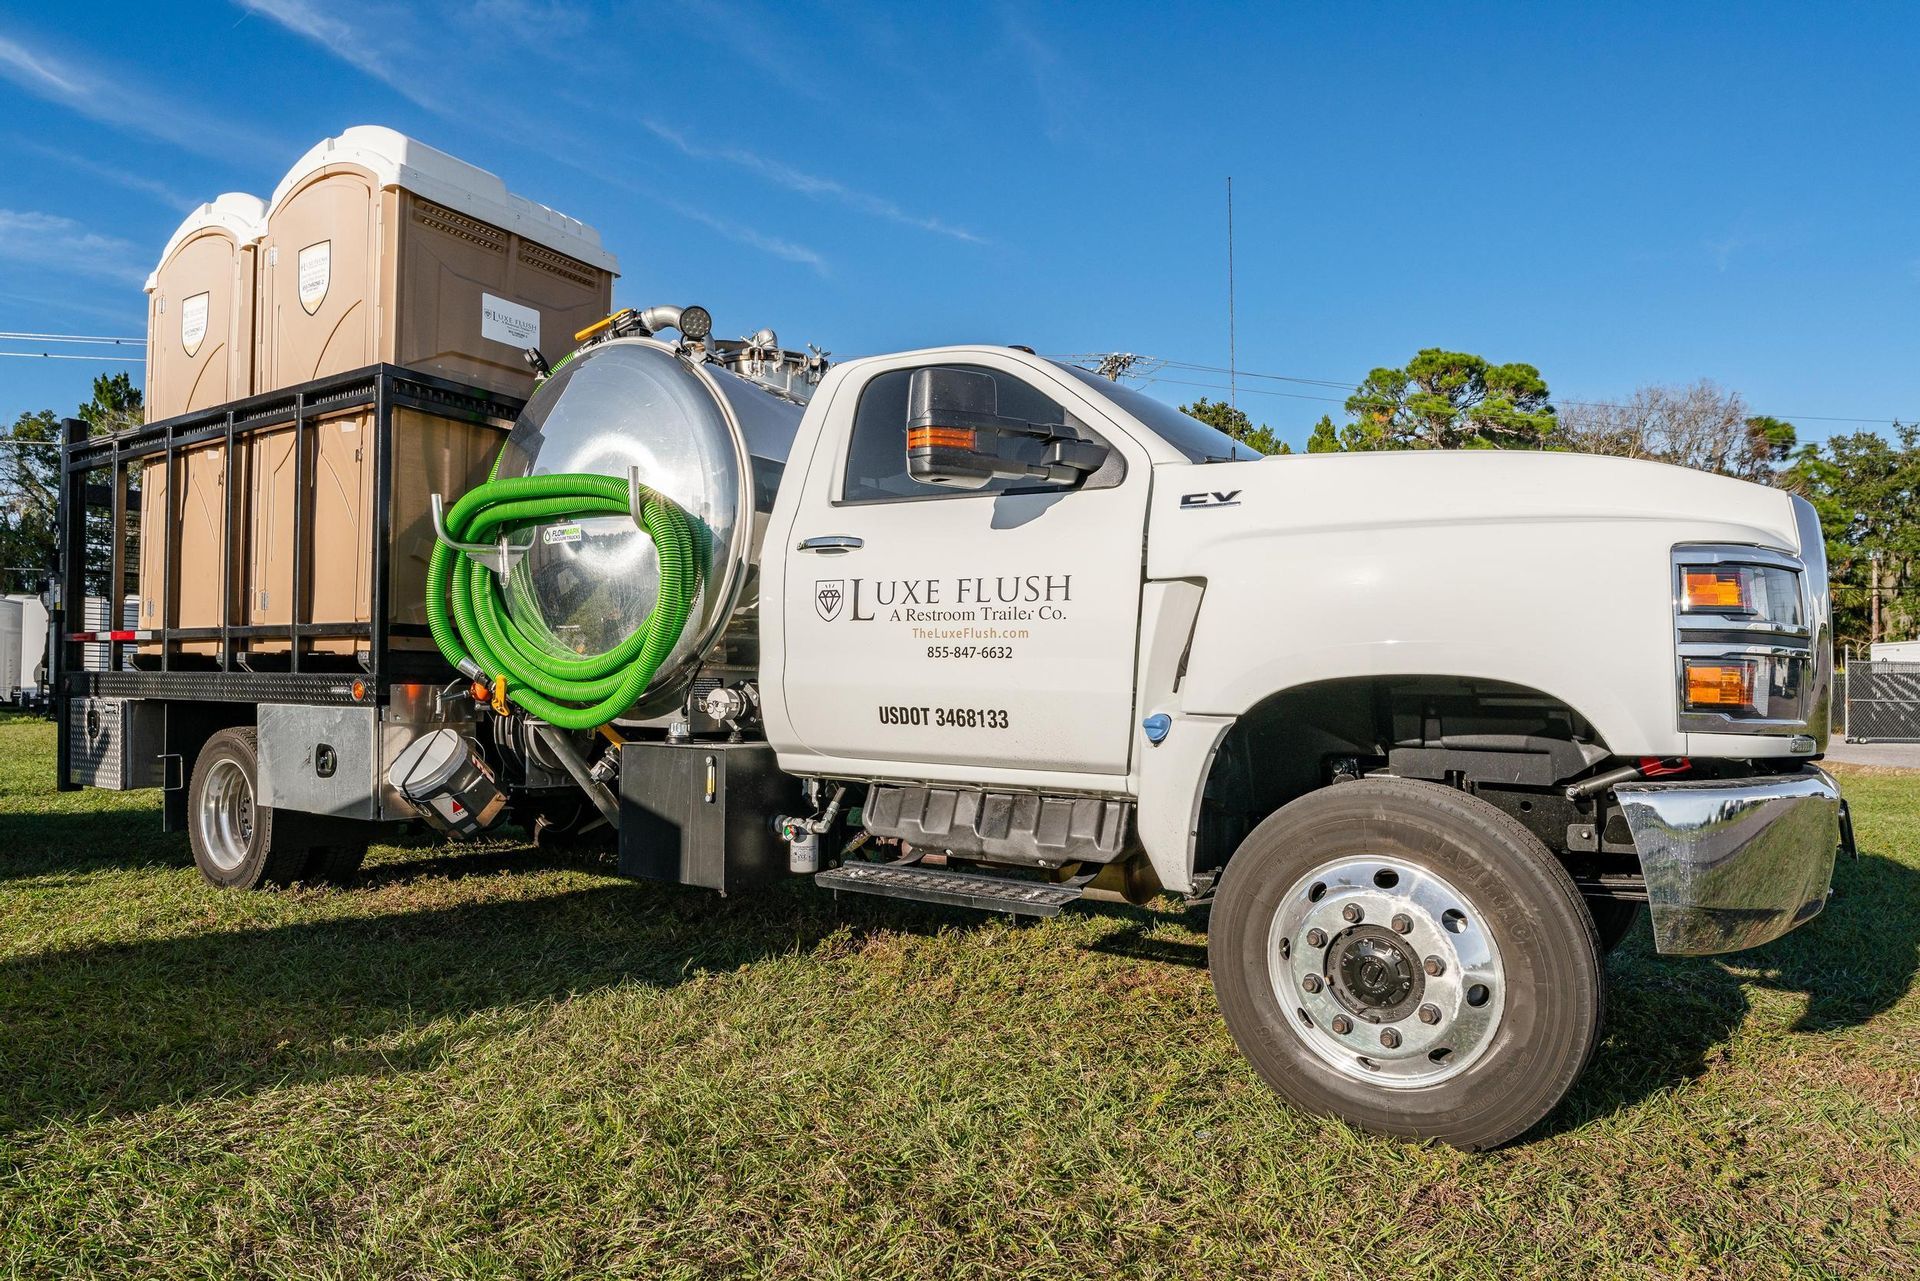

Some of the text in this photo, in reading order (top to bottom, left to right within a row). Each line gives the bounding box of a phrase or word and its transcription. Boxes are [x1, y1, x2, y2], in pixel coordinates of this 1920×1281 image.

[1180, 489, 1243, 505] CV
[849, 574, 1072, 621] LUXE FLUSH
[889, 605, 1067, 621] A Restroom Trailer Co.
[912, 627, 1029, 639] TheLuxeFlush.com
[927, 646, 1013, 659] 855-847-6632
[878, 706, 1009, 729] USDOT 3468133
